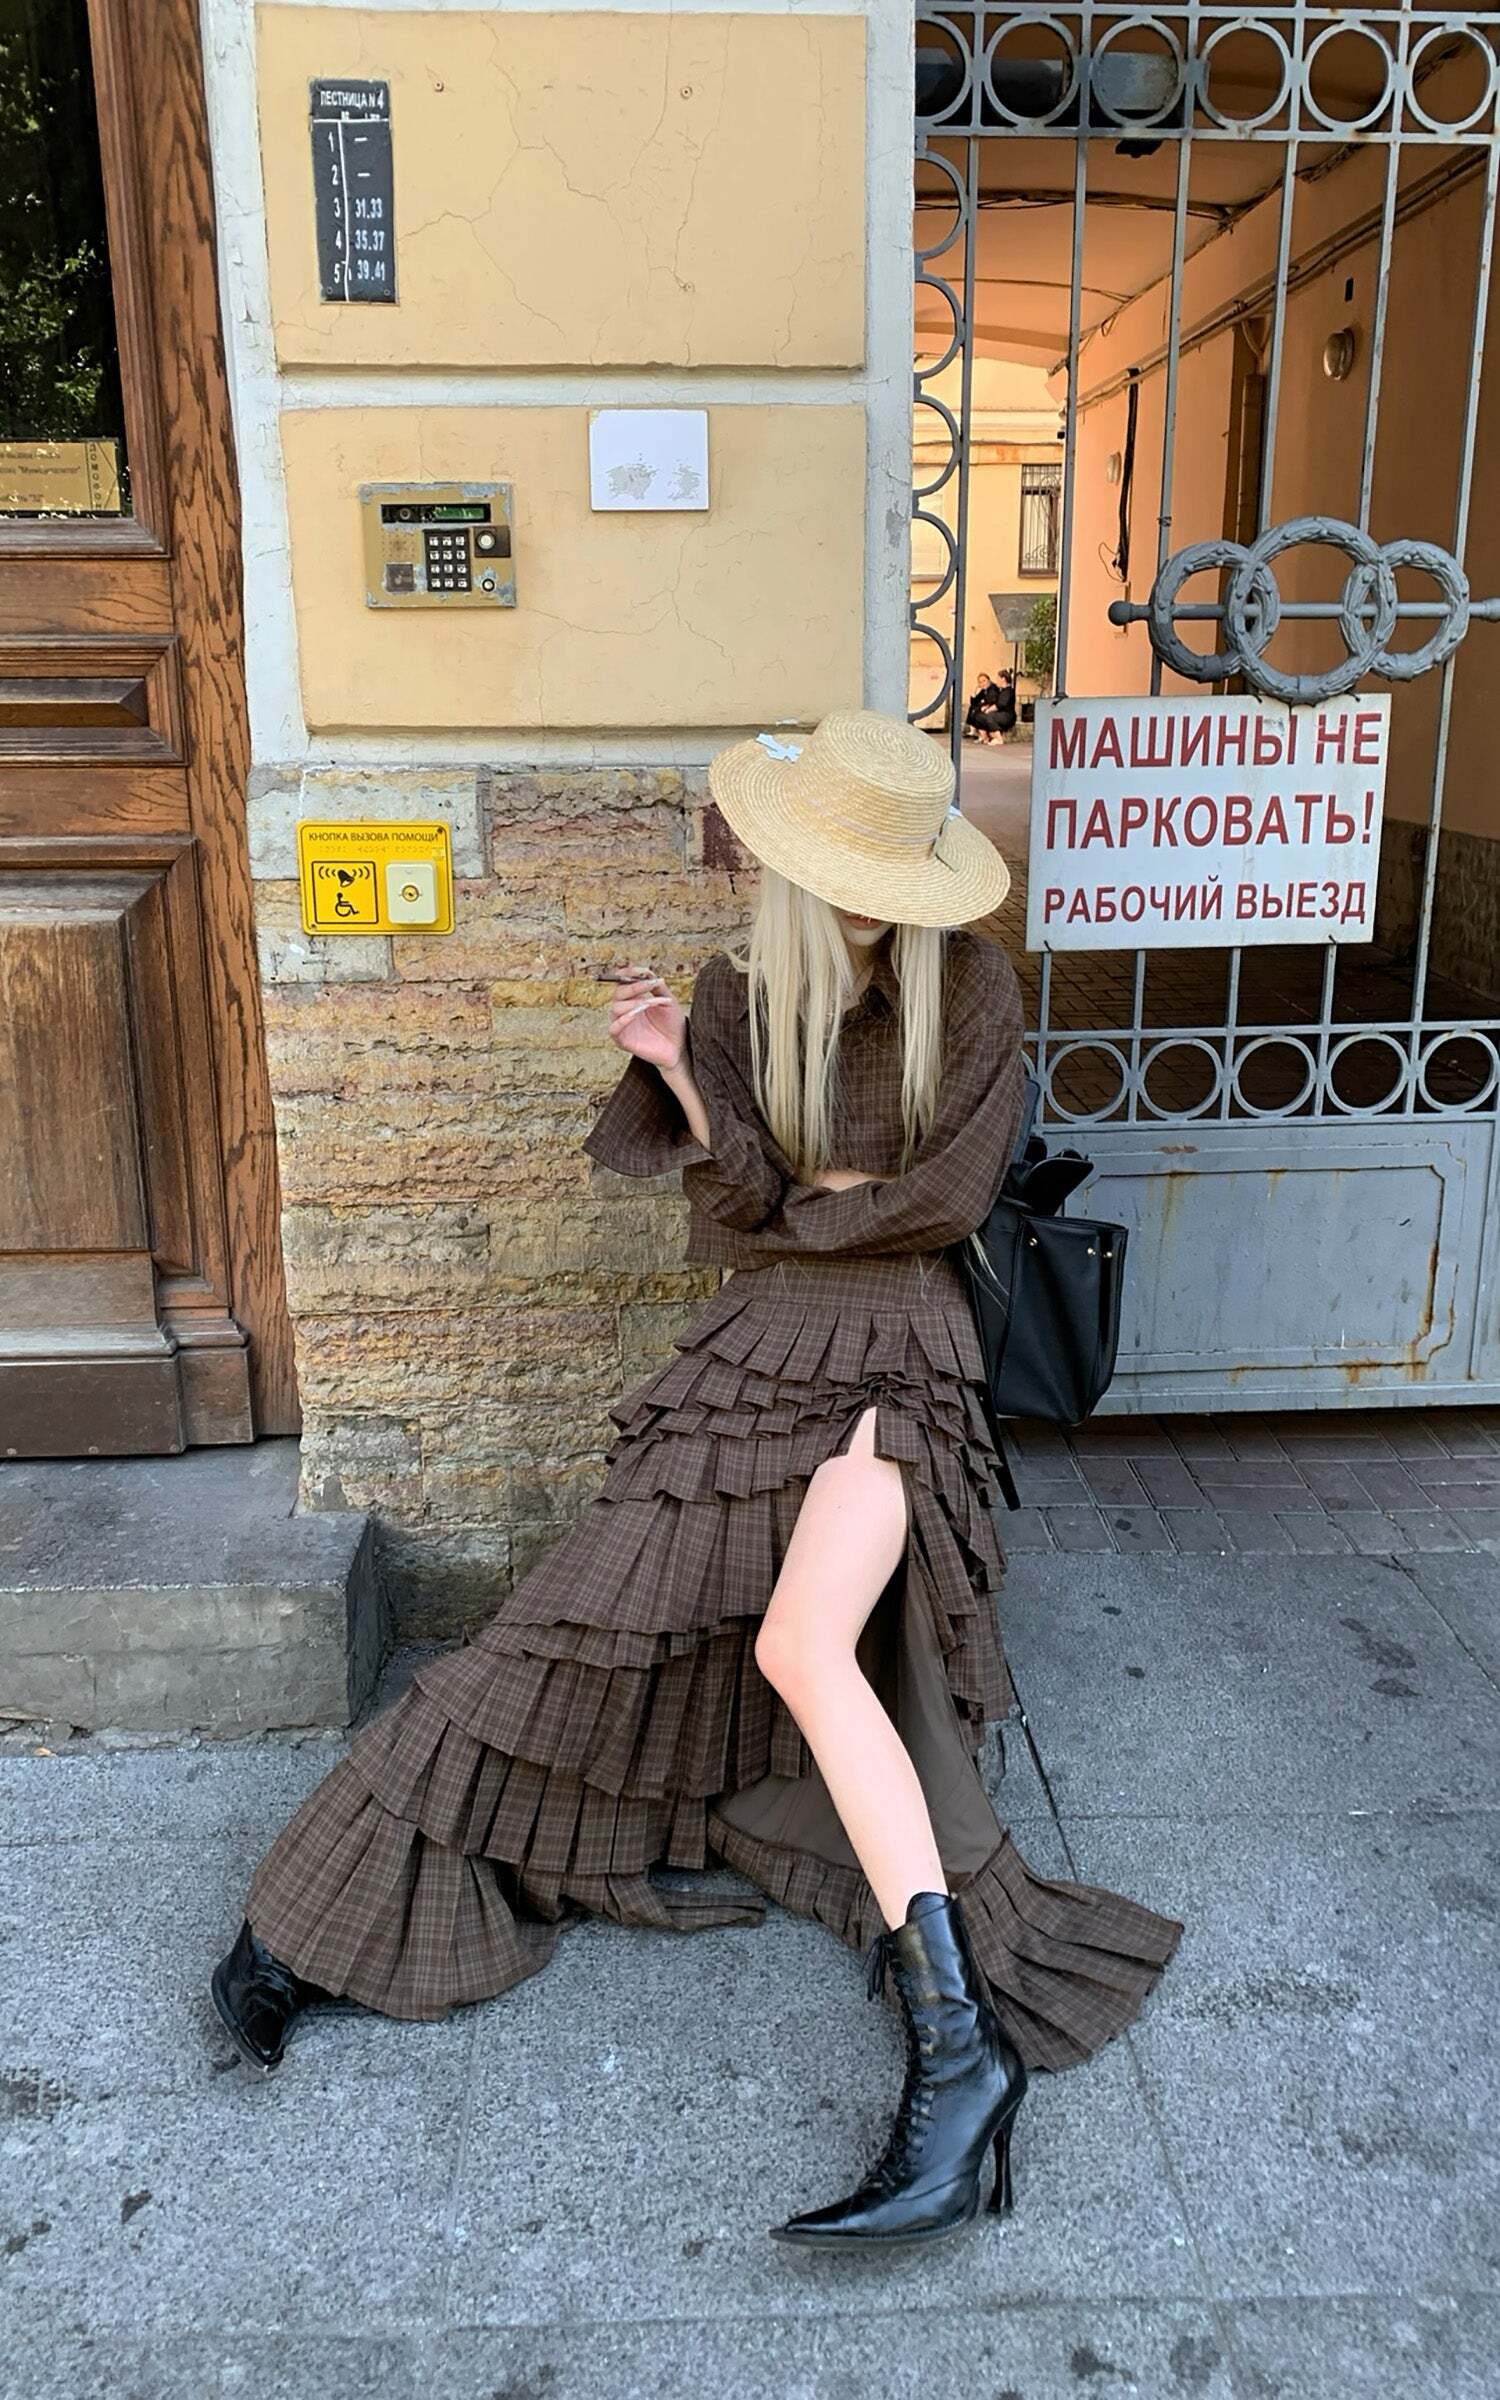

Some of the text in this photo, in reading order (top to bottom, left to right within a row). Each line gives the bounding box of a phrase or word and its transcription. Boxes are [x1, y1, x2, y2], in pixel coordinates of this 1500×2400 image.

[377, 88, 384, 110] 4
[327, 131, 334, 152] 1
[331, 164, 339, 185] 2
[333, 197, 383, 219] 3 31.33
[335, 229, 385, 251] 4 35.37
[333, 259, 385, 284] 5 39.41
[1049, 712, 1383, 770] МАШИНЫ НЕ
[1045, 791, 1375, 850] ПАРКОВАТЬ!
[308, 832, 439, 843] КНОПКА ВЫЗОВА ПОМОЩИ
[1043, 874, 1368, 926] РАБОЧИЙ ВЫЕЗД
